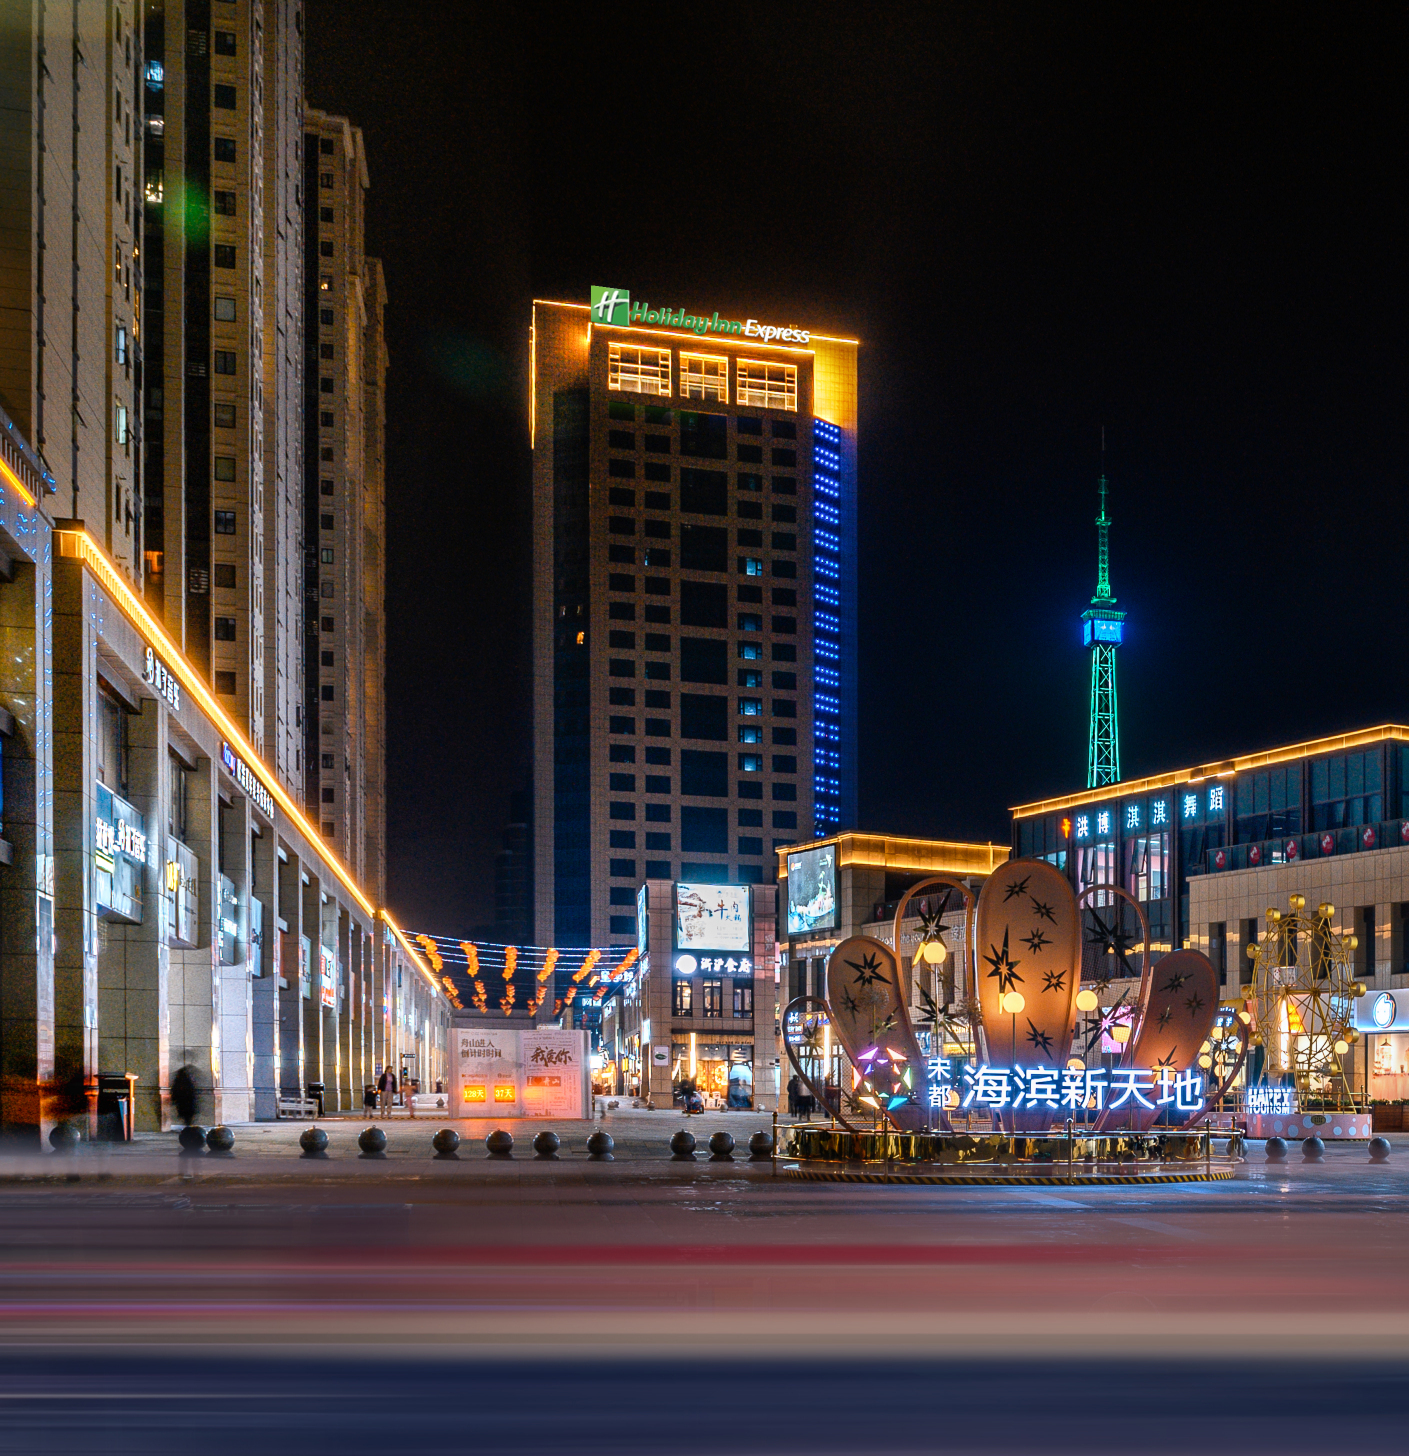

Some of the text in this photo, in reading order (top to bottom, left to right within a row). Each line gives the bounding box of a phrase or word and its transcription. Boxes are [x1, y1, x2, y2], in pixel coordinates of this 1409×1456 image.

[630, 301, 811, 344] Holiday Inn Express
[495, 1088, 513, 1098] 37天
[963, 1064, 1203, 1110] 海滨新天地
[1247, 1087, 1291, 1102] HAPPY
[1248, 1101, 1290, 1115] TOURISM
